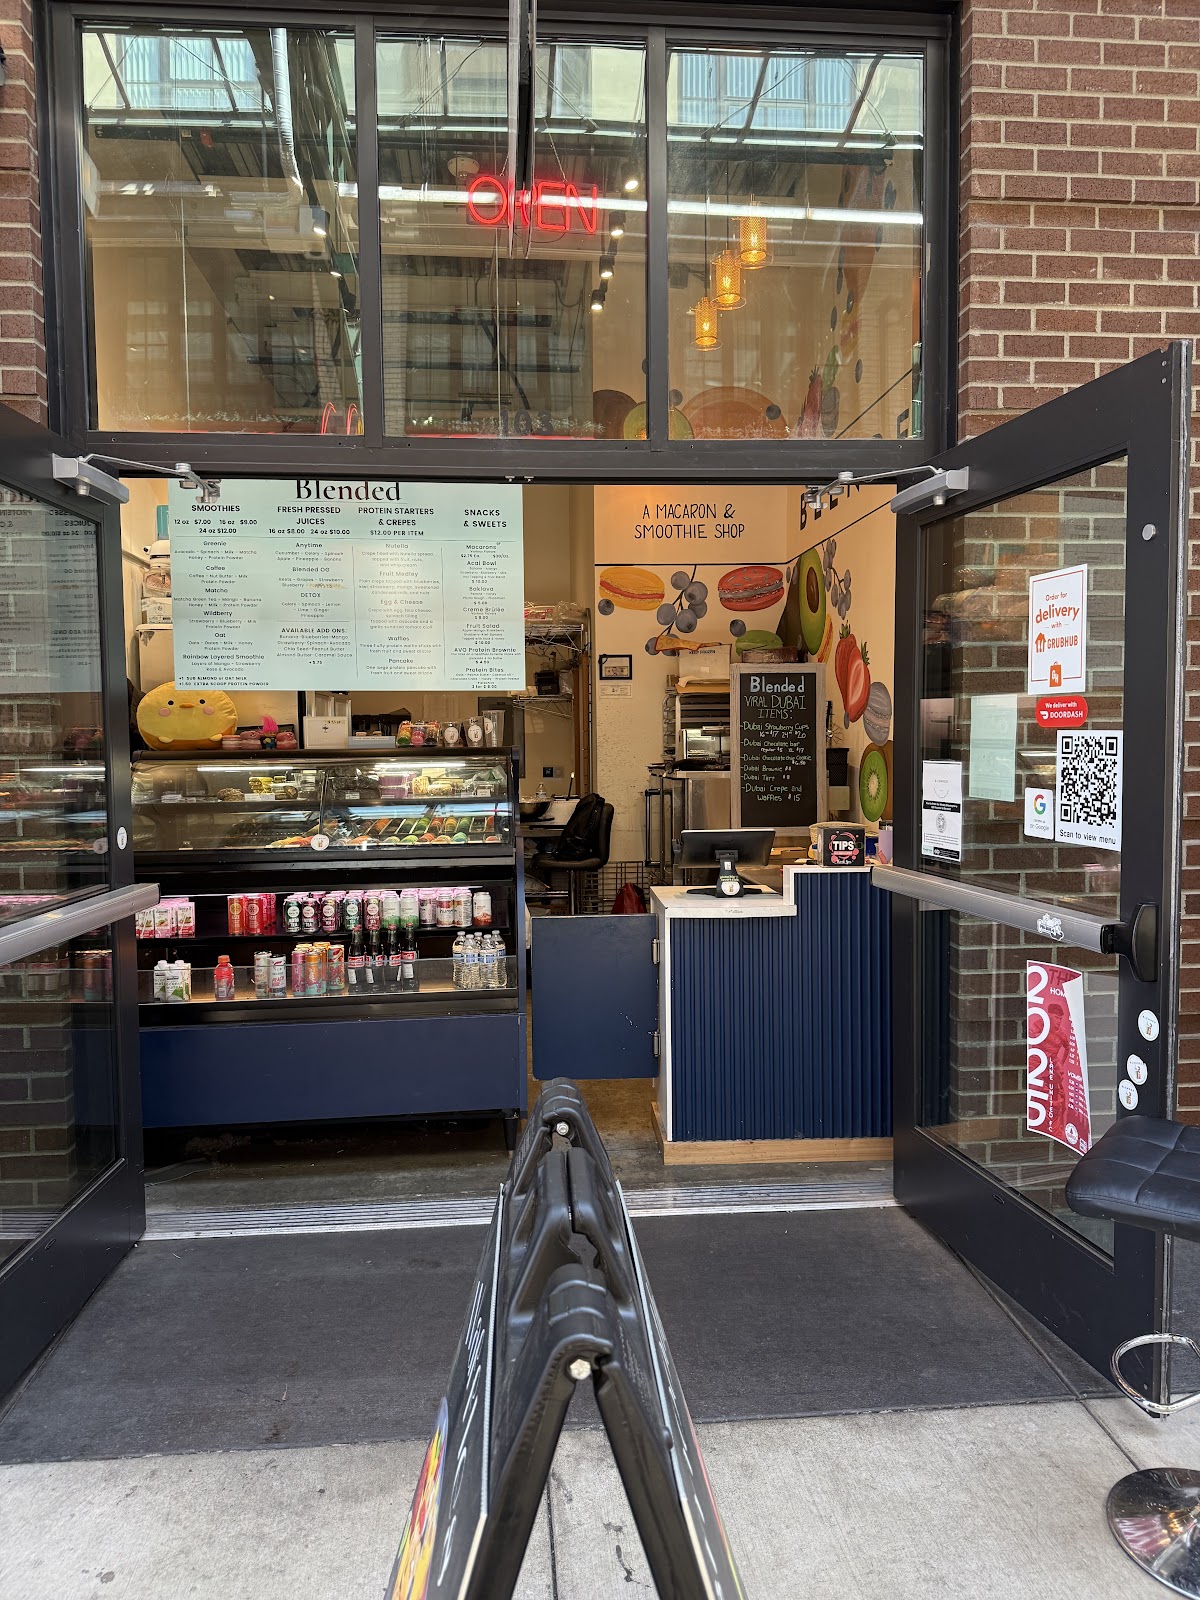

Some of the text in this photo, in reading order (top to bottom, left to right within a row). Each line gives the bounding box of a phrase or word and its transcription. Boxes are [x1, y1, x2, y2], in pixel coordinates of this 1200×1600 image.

[500, 408, 554, 436] 103
[295, 480, 402, 501] Blended
[191, 504, 241, 512] SMOOTHIES
[305, 506, 341, 514] PRESSED
[394, 507, 434, 515] STARTERS
[642, 503, 736, 519] A MACARON &
[378, 518, 384, 526] &
[634, 523, 745, 539] SMOOTHIE SHOP
[1045, 591, 1068, 602] Order for
[1035, 603, 1080, 624] delivery
[1051, 621, 1062, 630] with
[1047, 634, 1079, 650] GRUBHUB
[750, 675, 805, 693] Blended
[744, 694, 807, 710] VIRAL DUBAI
[1067, 701, 1078, 709] with
[757, 708, 793, 720] ITEMS:
[1050, 711, 1083, 719] DOORDASH
[794, 722, 810, 731] Cups
[769, 784, 788, 793] Crepe
[1035, 823, 1050, 832] Google
[1059, 829, 1117, 845] Scan to view menu
[832, 841, 855, 851] TIPS
